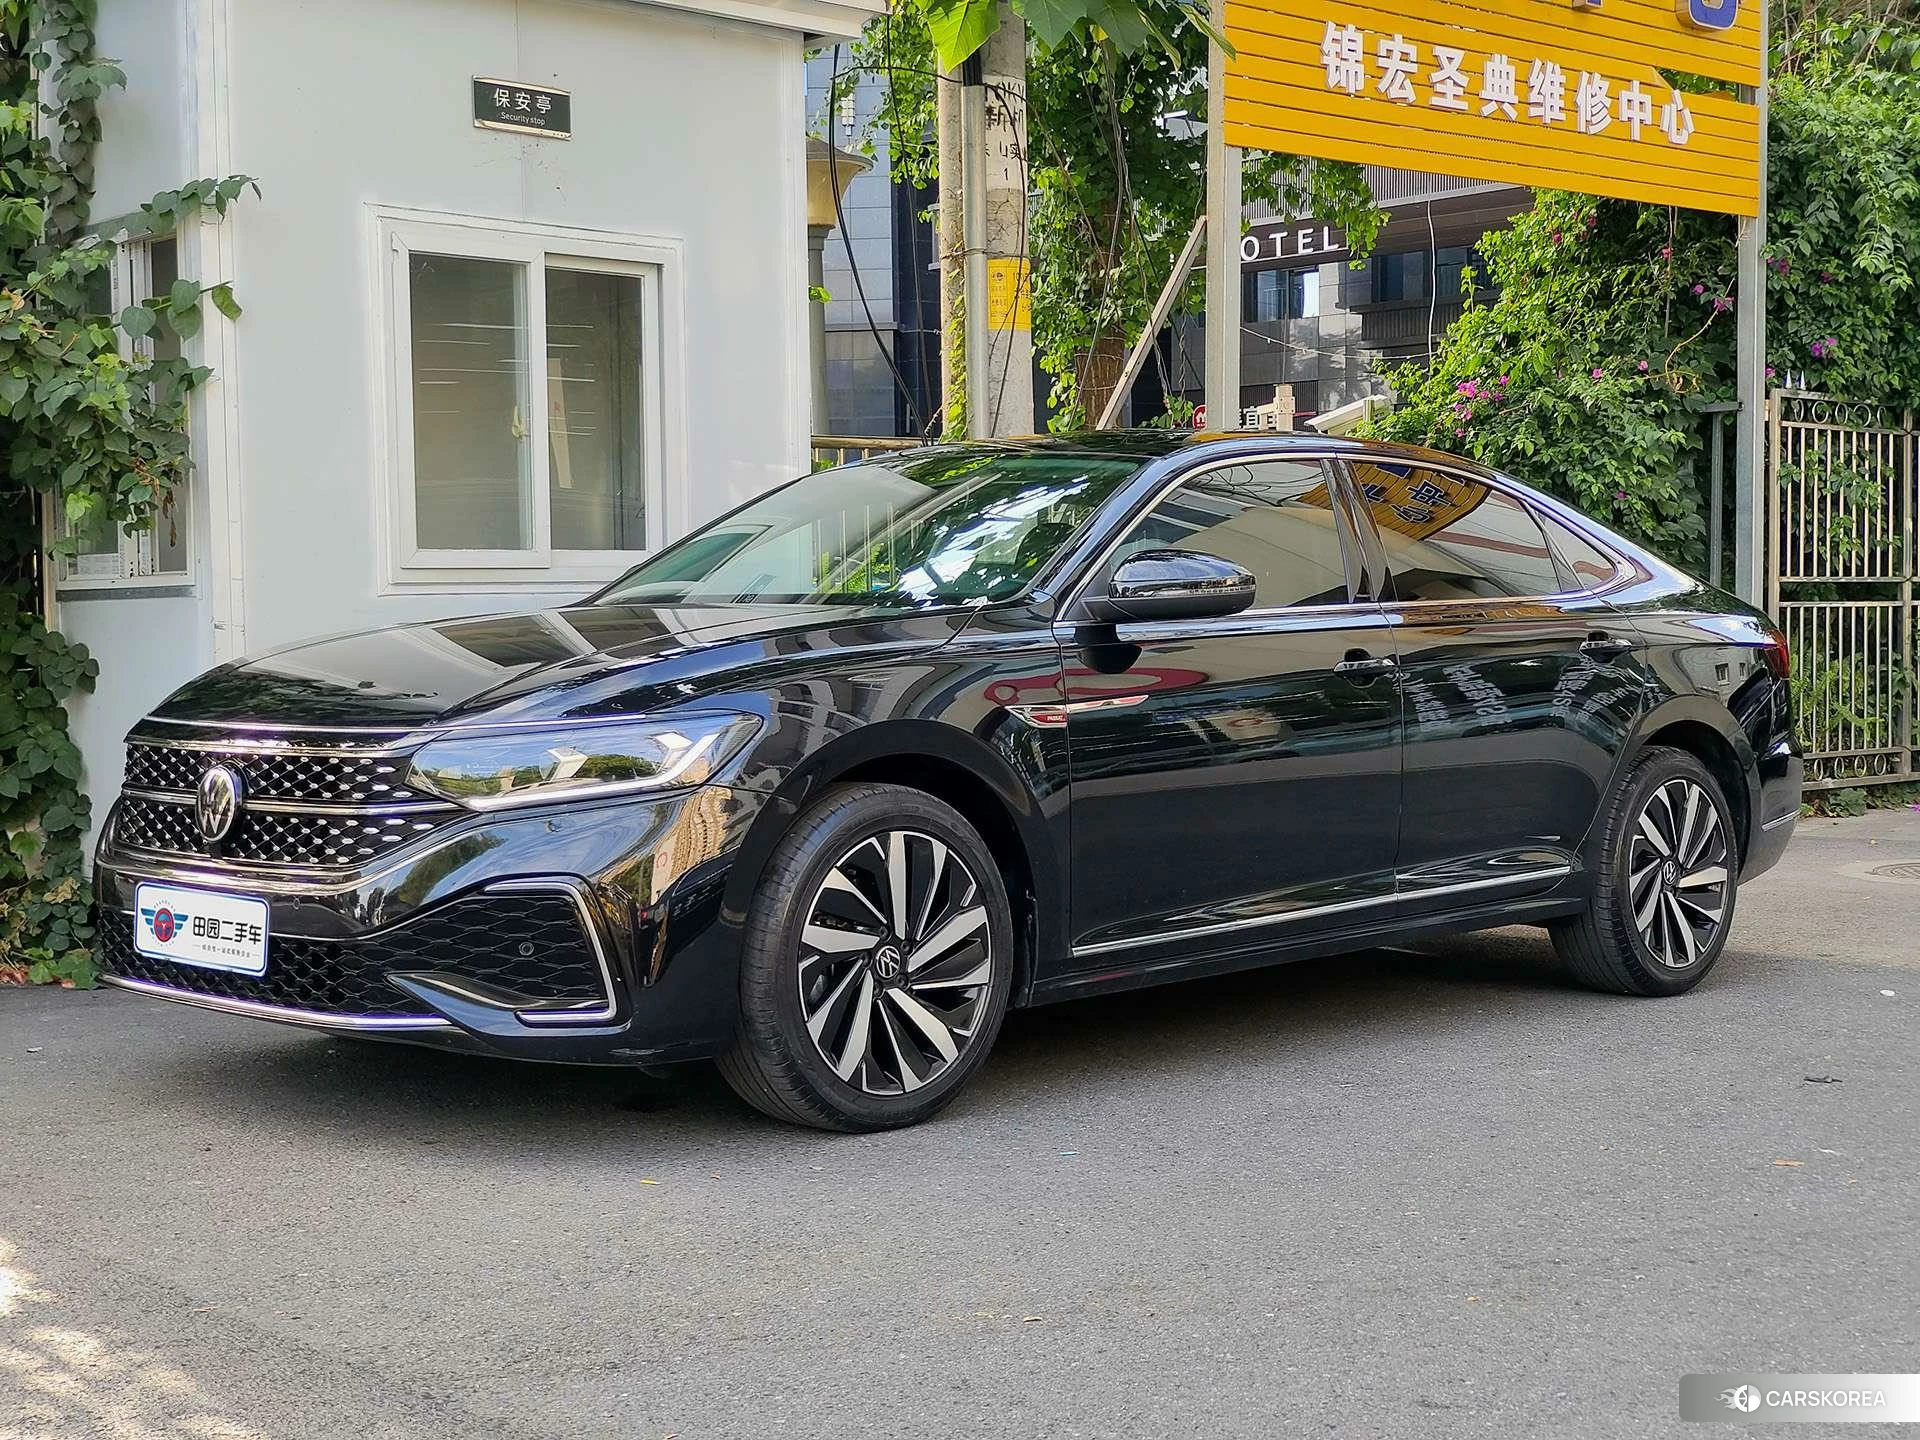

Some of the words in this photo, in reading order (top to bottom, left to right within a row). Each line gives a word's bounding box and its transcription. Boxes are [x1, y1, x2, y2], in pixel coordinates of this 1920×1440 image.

[1320, 20, 1695, 145] 锦宏圣典维修中心
[493, 87, 552, 114] 保安亭
[500, 111, 530, 124] Security
[530, 116, 546, 126] stop
[1240, 226, 1340, 261] OTEL
[192, 916, 262, 945] 田园二手车
